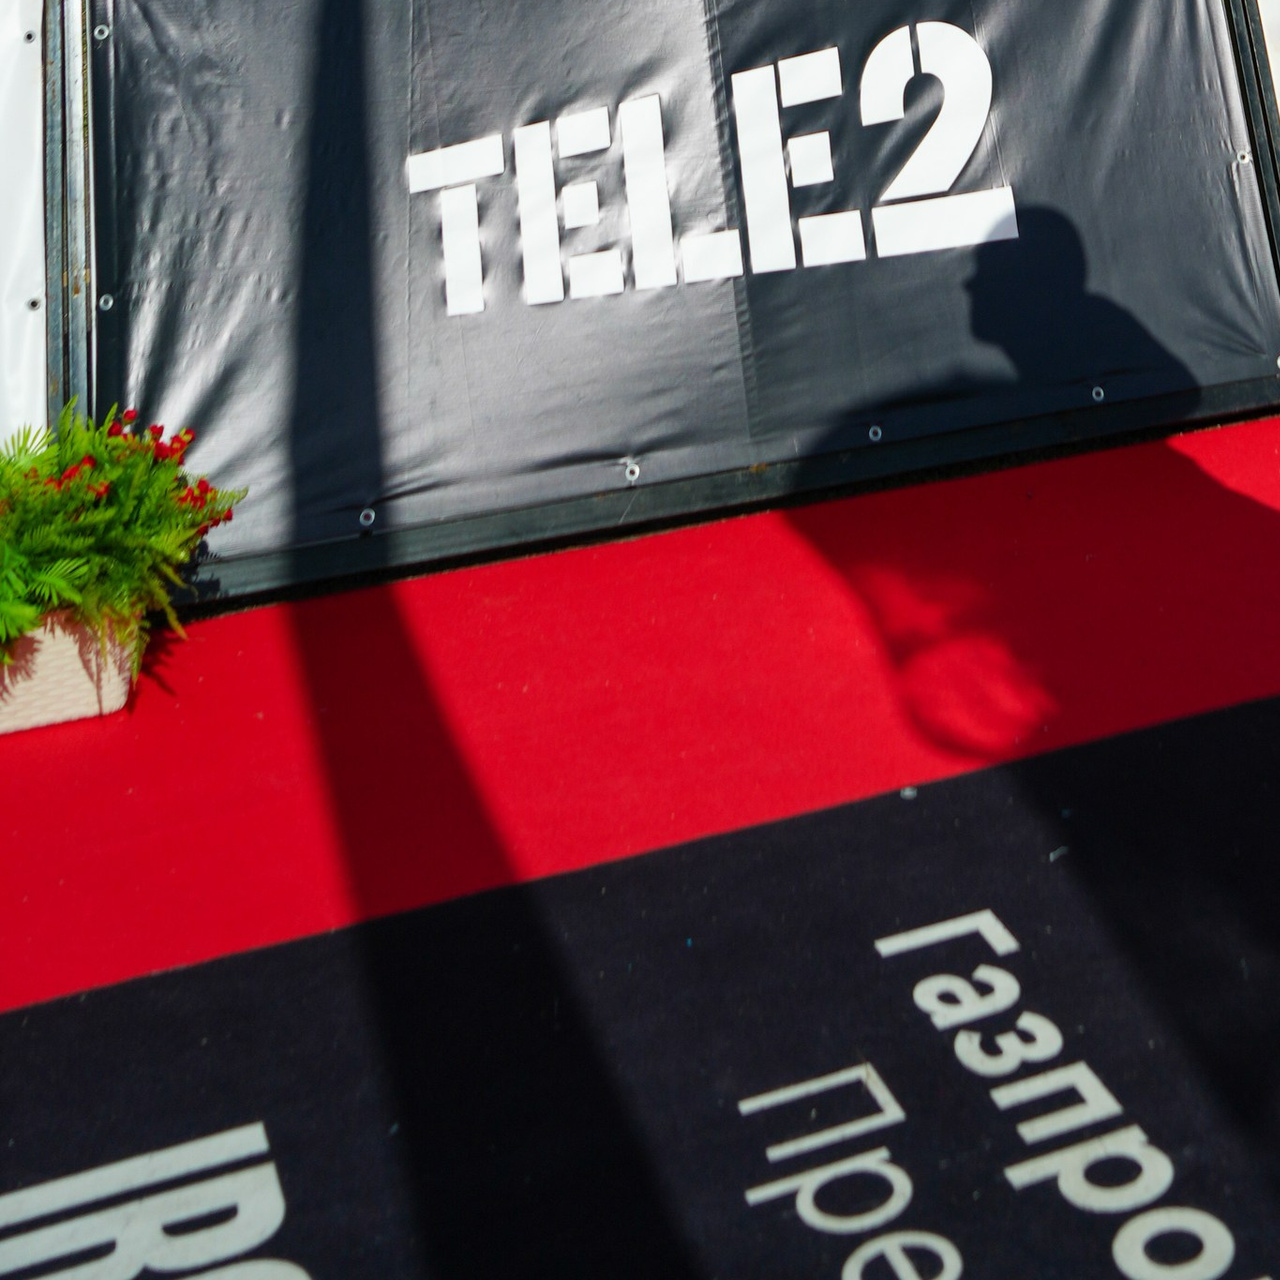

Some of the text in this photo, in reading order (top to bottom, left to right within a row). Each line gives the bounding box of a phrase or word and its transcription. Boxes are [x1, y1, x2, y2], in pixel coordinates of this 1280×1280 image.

[407, 20, 1019, 316] TELE2
[0, 1121, 312, 1280] IR
[874, 908, 1273, 1280] Газпро
